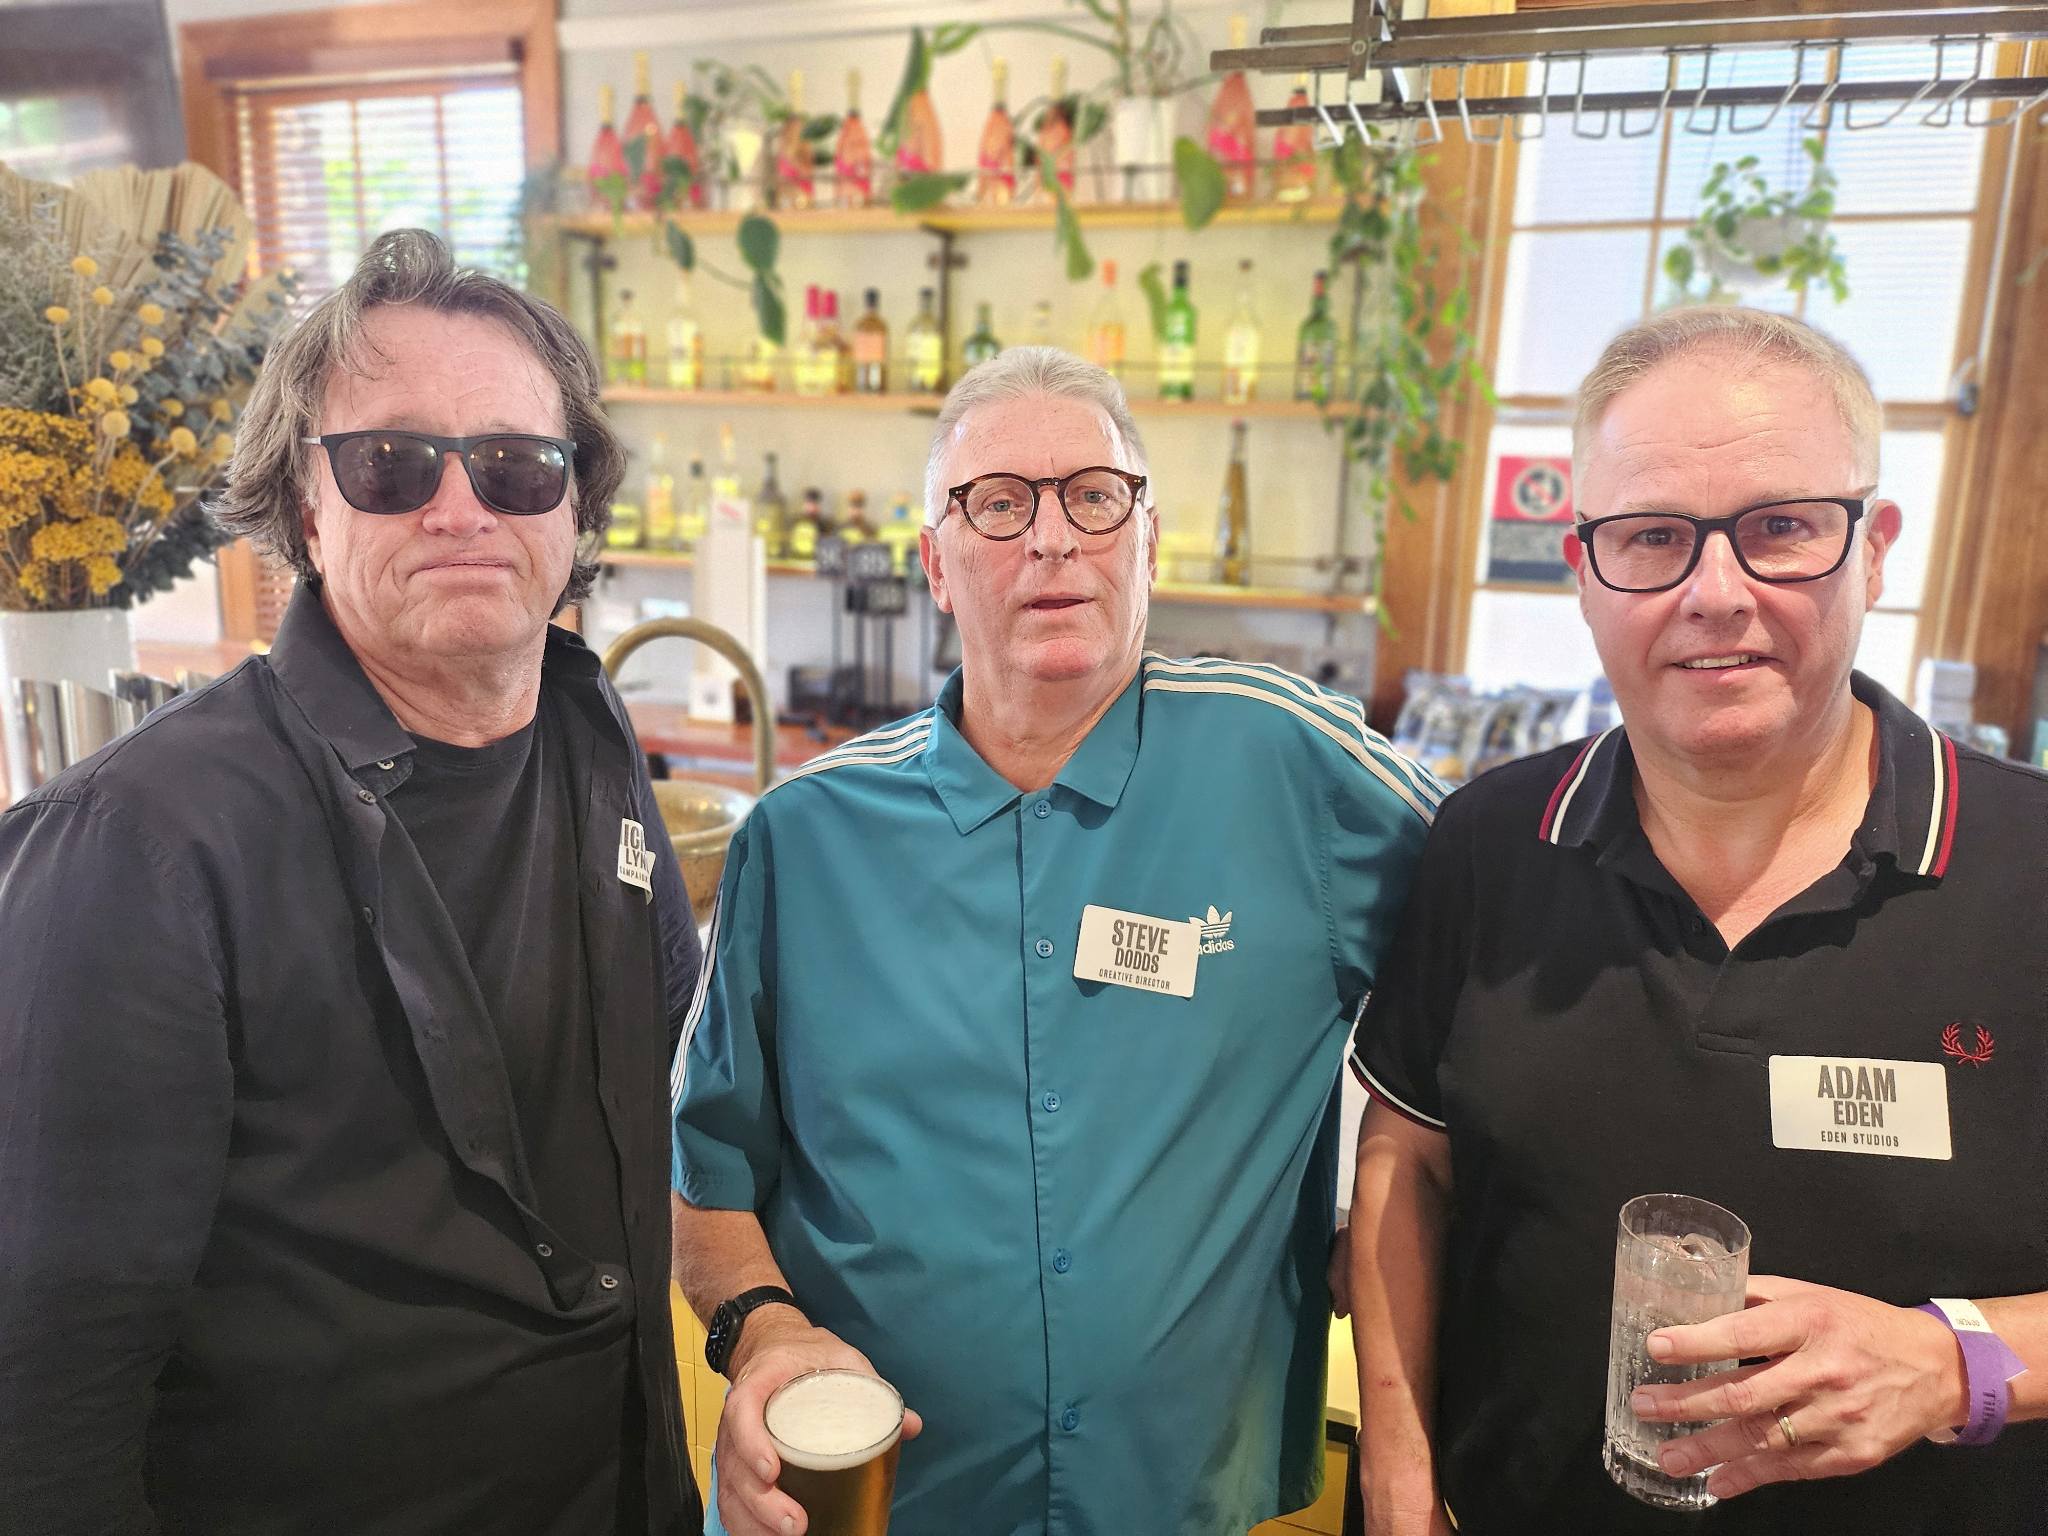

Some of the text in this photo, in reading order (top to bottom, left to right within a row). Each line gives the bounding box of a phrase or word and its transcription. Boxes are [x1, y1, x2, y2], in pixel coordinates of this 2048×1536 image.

[1112, 919, 1170, 955] STEVE
[1115, 947, 1160, 974] DODDS
[1099, 968, 1170, 990] CREATIVE DIRECTOR
[1817, 1065, 1897, 1102] ADAM
[1833, 1100, 1884, 1128] EDEN
[1821, 1130, 1899, 1147] EDEN STUDIOS
